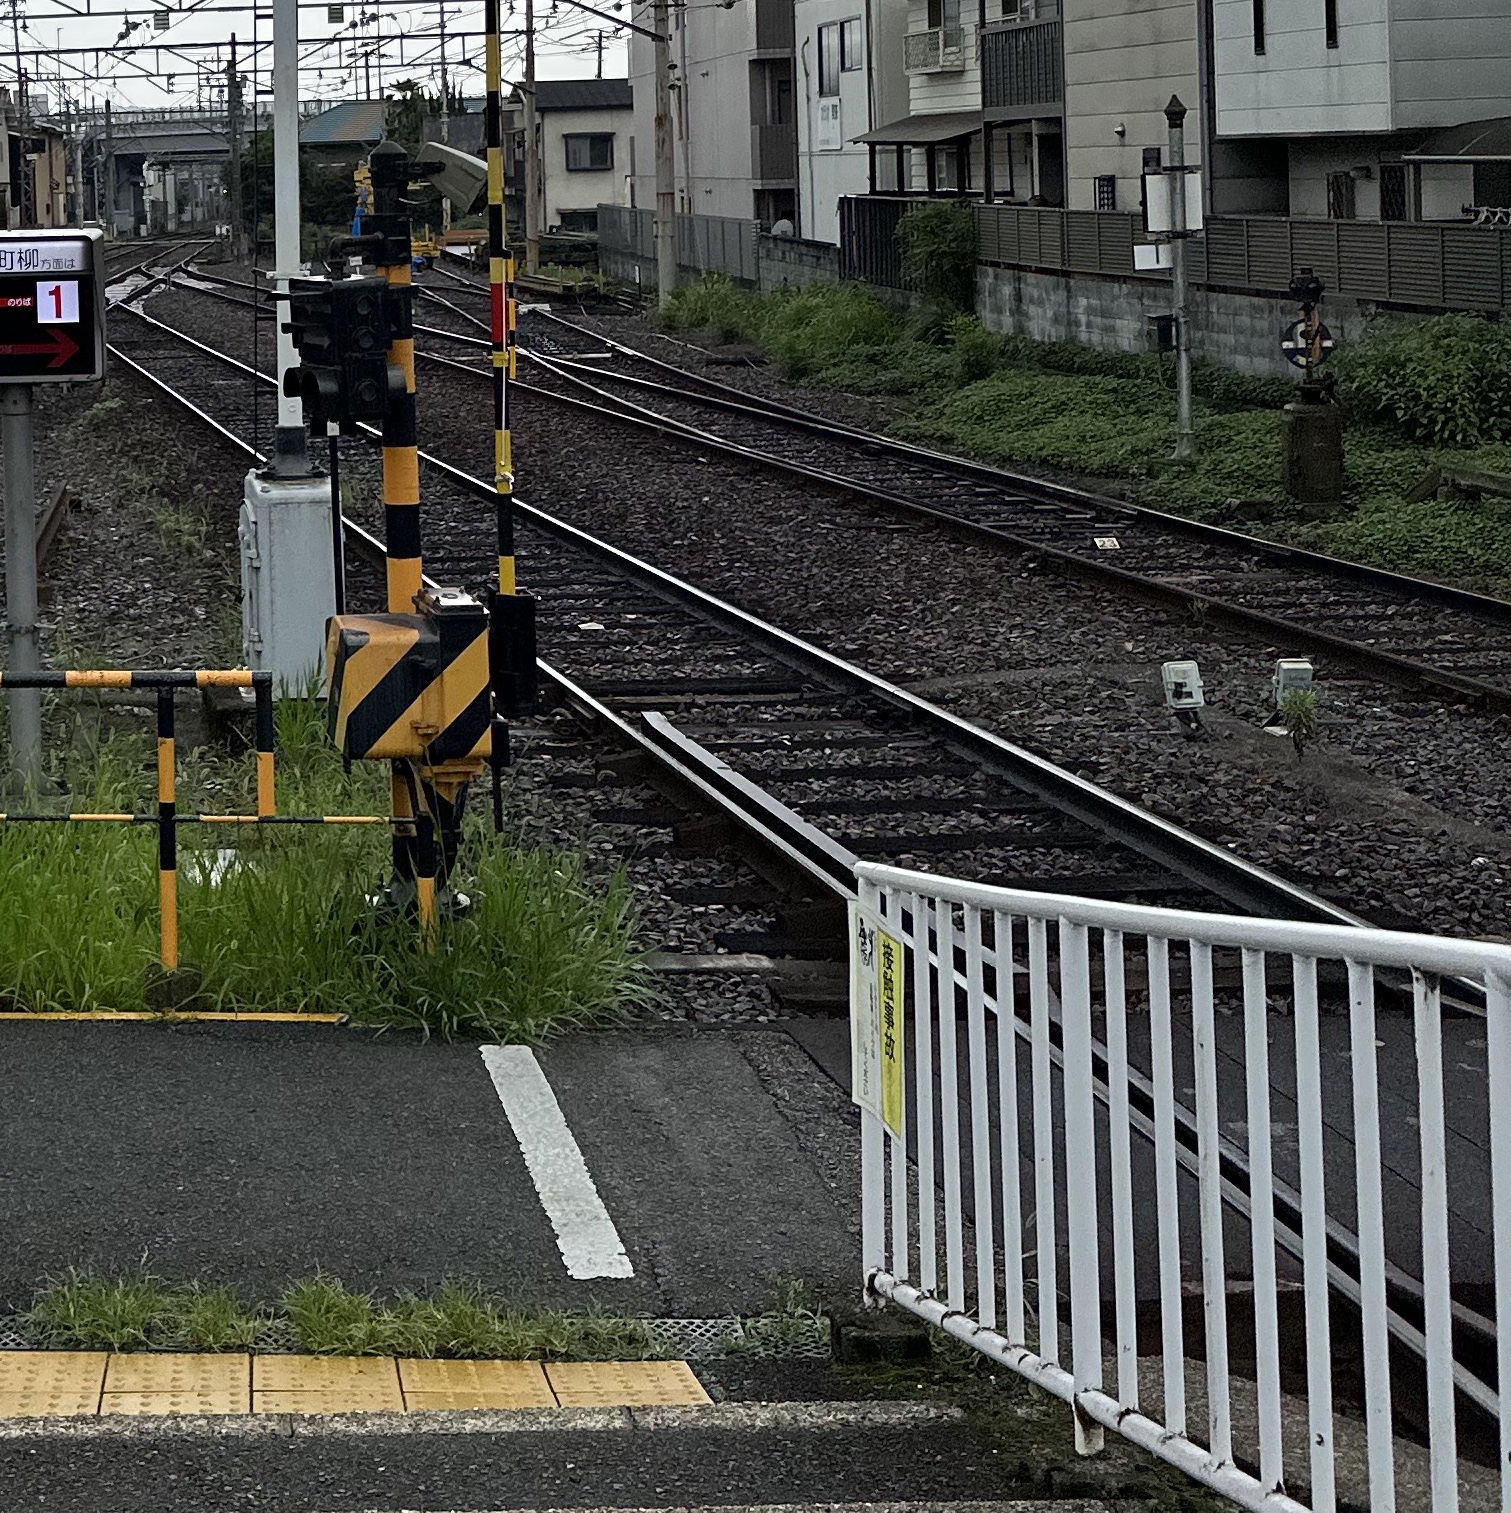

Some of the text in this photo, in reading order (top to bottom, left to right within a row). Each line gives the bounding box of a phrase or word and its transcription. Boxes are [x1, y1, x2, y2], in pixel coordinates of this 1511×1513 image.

[7, 285, 62, 319] のりば 1
